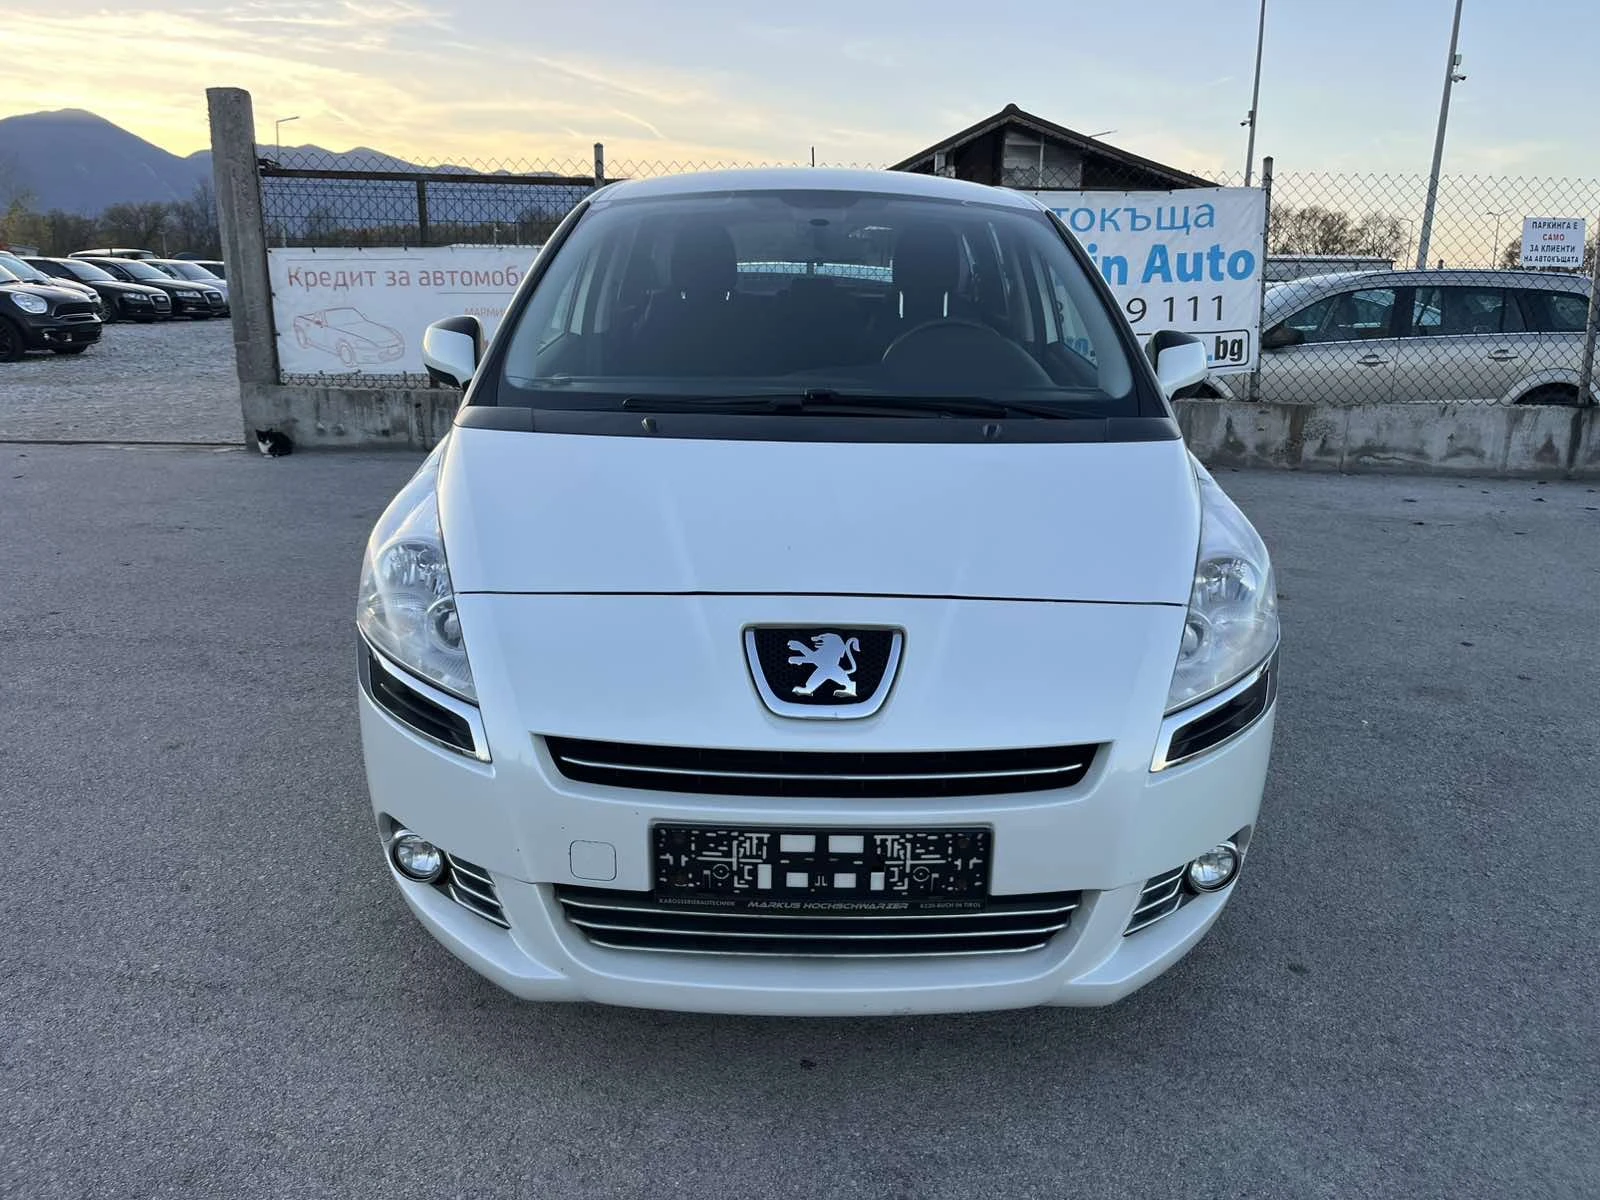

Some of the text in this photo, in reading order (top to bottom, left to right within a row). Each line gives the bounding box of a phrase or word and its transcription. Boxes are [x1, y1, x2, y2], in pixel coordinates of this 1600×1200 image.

[1532, 221, 1578, 230] ПАРКИНГА Е
[1542, 233, 1565, 241] САМО
[1530, 244, 1576, 253] ЗА КЛИЕНТИ
[1141, 244, 1255, 283] Auto
[287, 266, 377, 293] Кредит
[385, 270, 410, 287] за
[1163, 294, 1224, 323] 111
[747, 901, 801, 910] MARKUS
